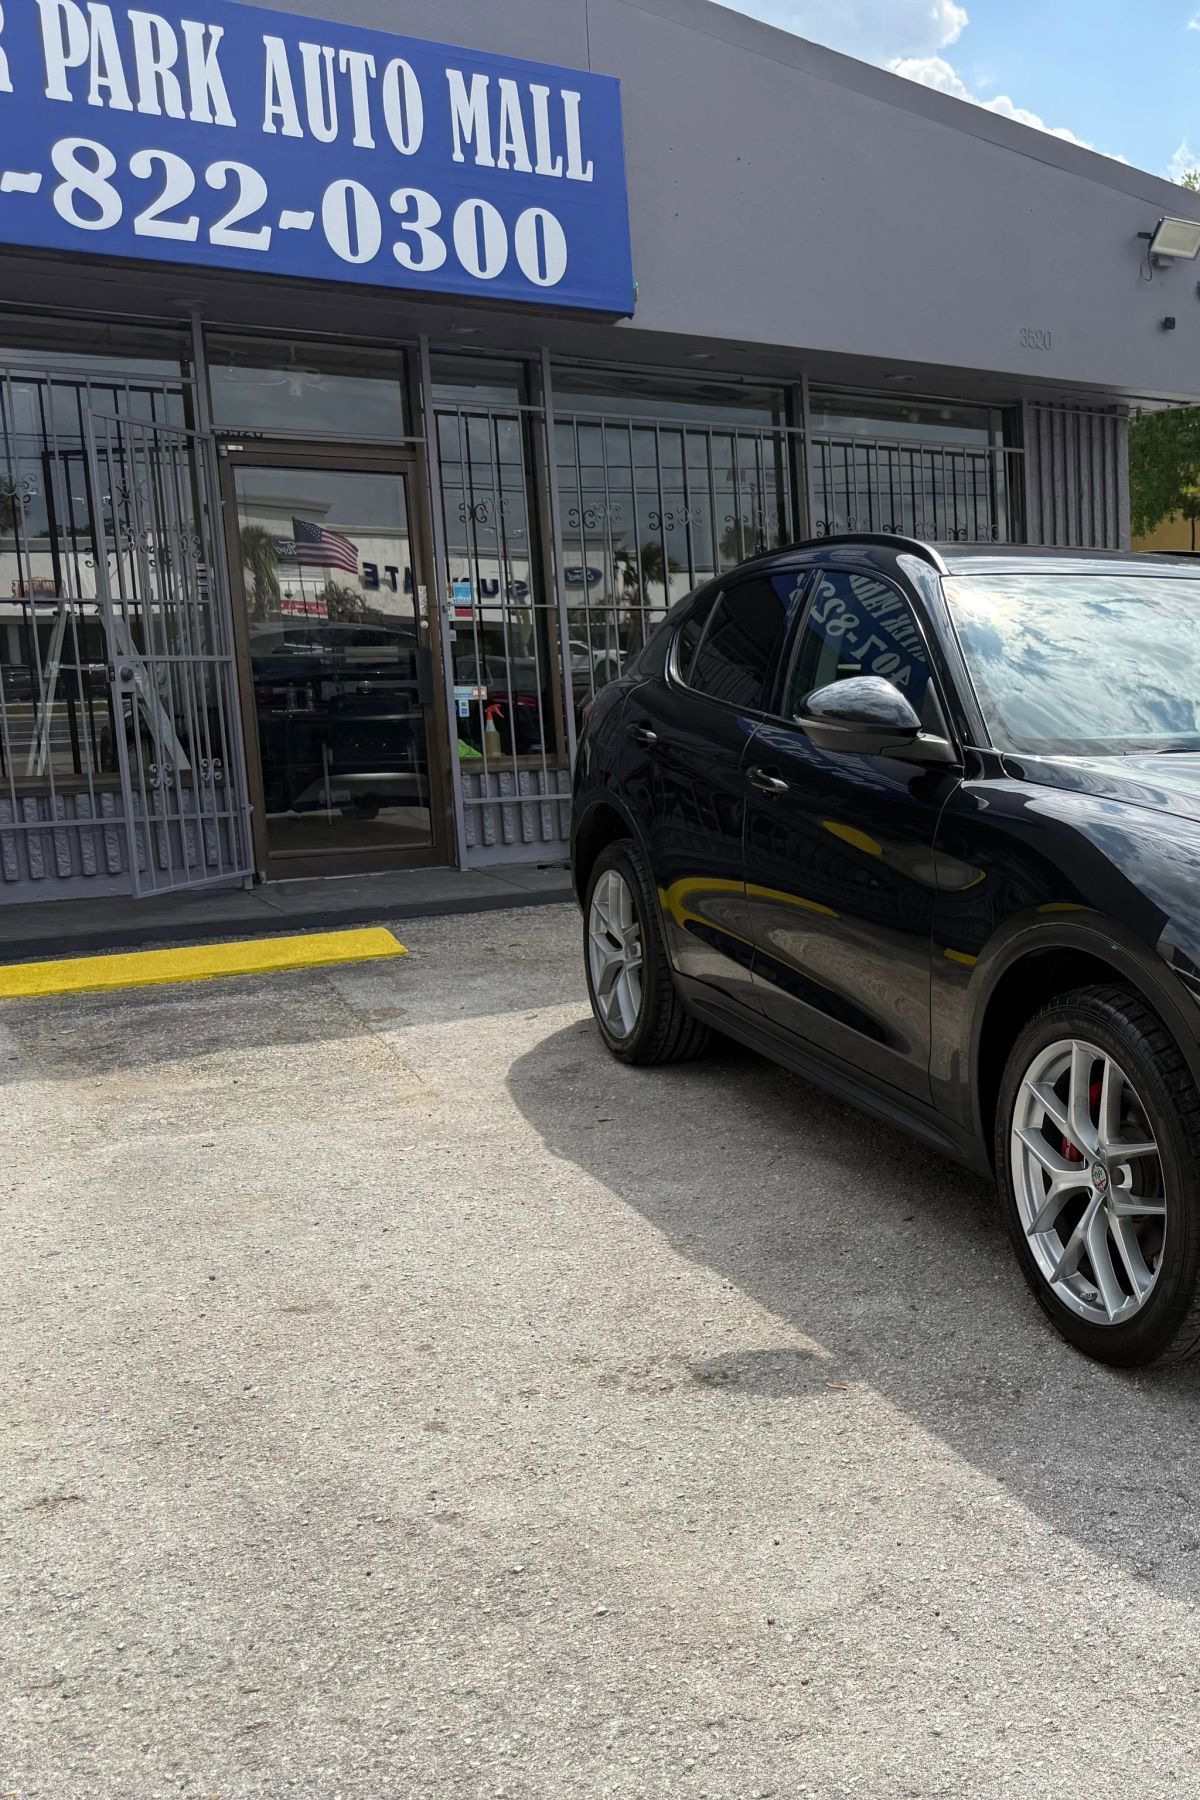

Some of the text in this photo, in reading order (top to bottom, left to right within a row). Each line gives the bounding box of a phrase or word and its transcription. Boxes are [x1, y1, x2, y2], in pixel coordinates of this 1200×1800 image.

[36, 0, 237, 127] PARK
[257, 34, 424, 156] AUTO
[445, 68, 595, 183] MALL
